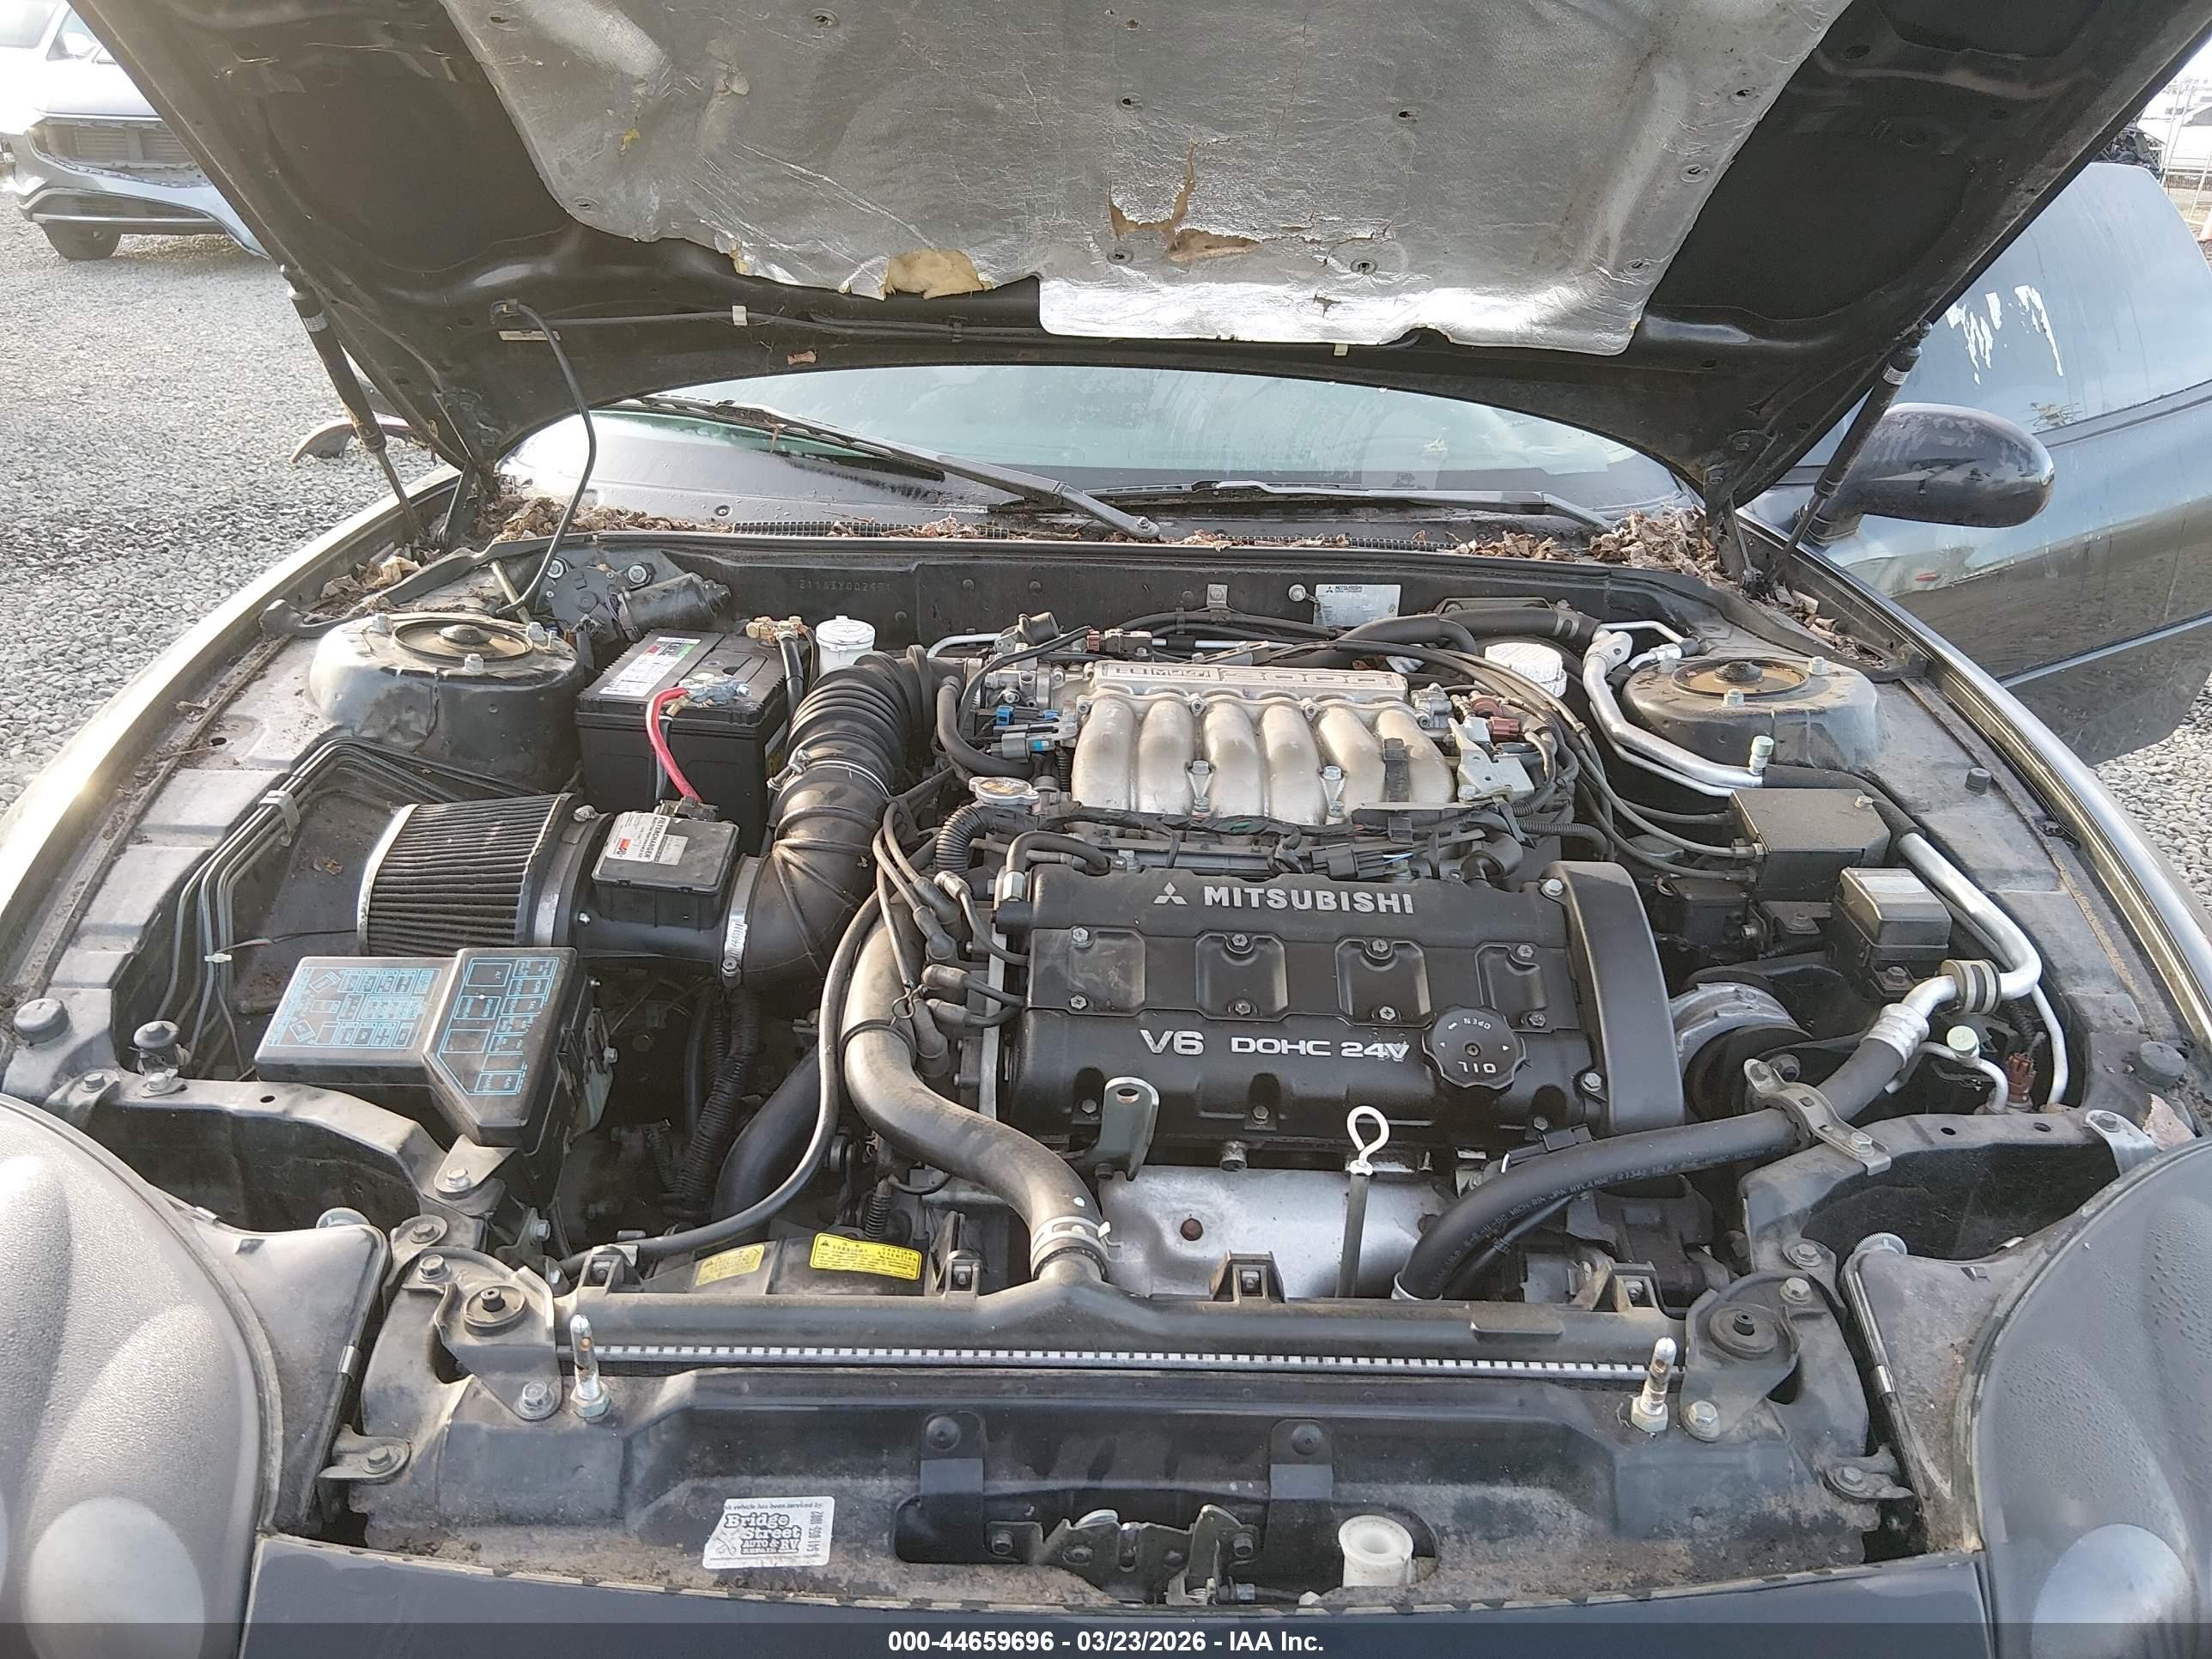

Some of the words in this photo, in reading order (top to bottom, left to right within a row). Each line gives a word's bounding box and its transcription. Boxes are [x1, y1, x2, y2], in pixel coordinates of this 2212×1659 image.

[1204, 885, 1414, 915] MITSUBISHI
[1462, 1017, 1492, 1030] OPEN
[1139, 1029, 1204, 1055] V6
[1231, 1036, 1332, 1057] DOHC
[1340, 1041, 1411, 1062] 24V
[1456, 1060, 1498, 1074] OIL
[724, 1512, 790, 1529] Bridge
[744, 1524, 802, 1540] Street
[742, 1539, 769, 1548] AUTO
[769, 1539, 780, 1548] &
[779, 1538, 800, 1551] RV
